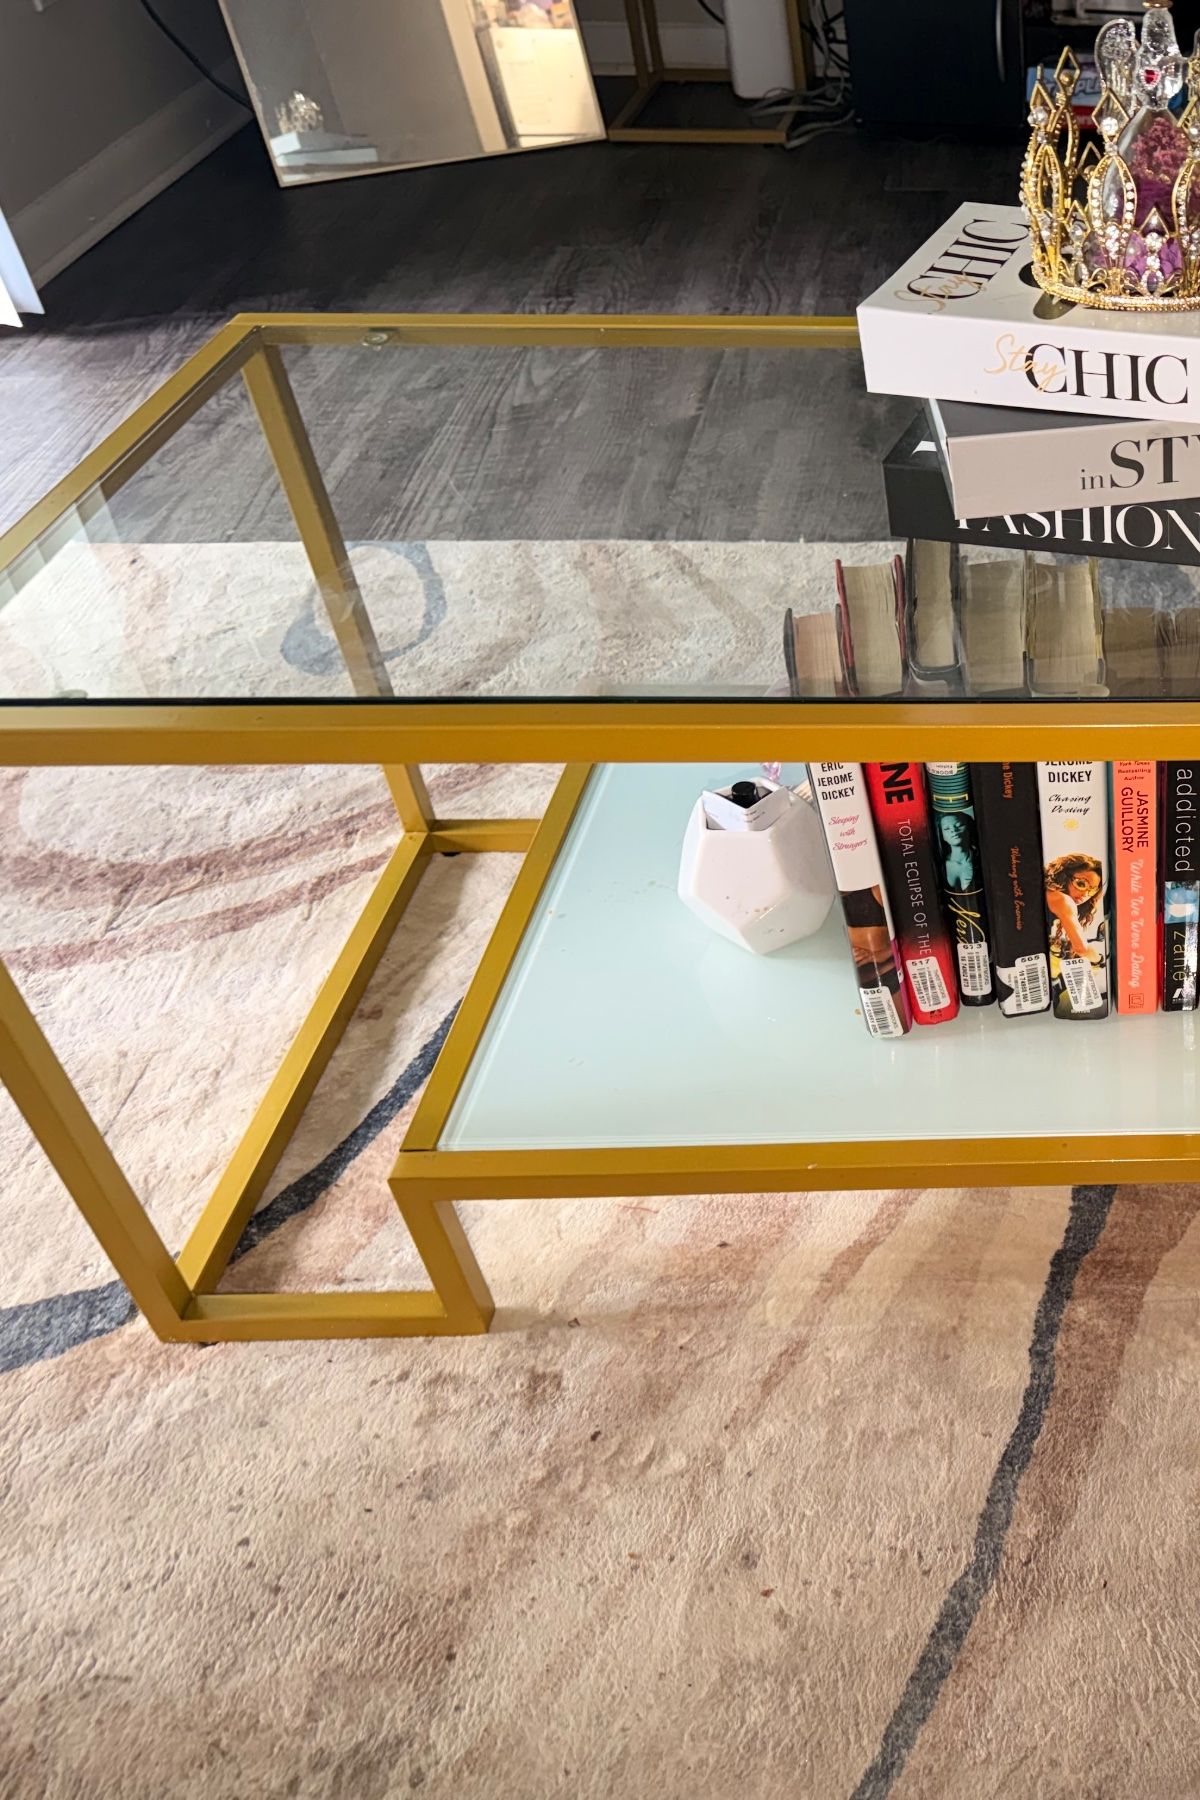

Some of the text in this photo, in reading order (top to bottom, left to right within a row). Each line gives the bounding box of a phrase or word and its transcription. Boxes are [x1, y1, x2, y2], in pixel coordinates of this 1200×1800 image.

[907, 218, 1031, 299] CHIC
[983, 333, 1188, 405] Stay CHIC
[821, 762, 844, 773] ERIC
[817, 772, 854, 787] JEROME
[1048, 770, 1092, 783] DICKEY
[1003, 771, 1014, 800] Dickey
[821, 786, 855, 801] DICKEY
[1048, 793, 1092, 804] Chasing
[1051, 804, 1090, 816] Destiny
[828, 814, 860, 826] Sleeping
[1121, 786, 1134, 853] GUILLORY
[1136, 790, 1149, 848] JASMINE
[1174, 768, 1198, 872] addicted
[839, 827, 856, 838] with
[832, 838, 868, 852] Strangers
[897, 818, 932, 956] TOTAL ECLIPSE OF THE
[1128, 951, 1145, 989] Dating
